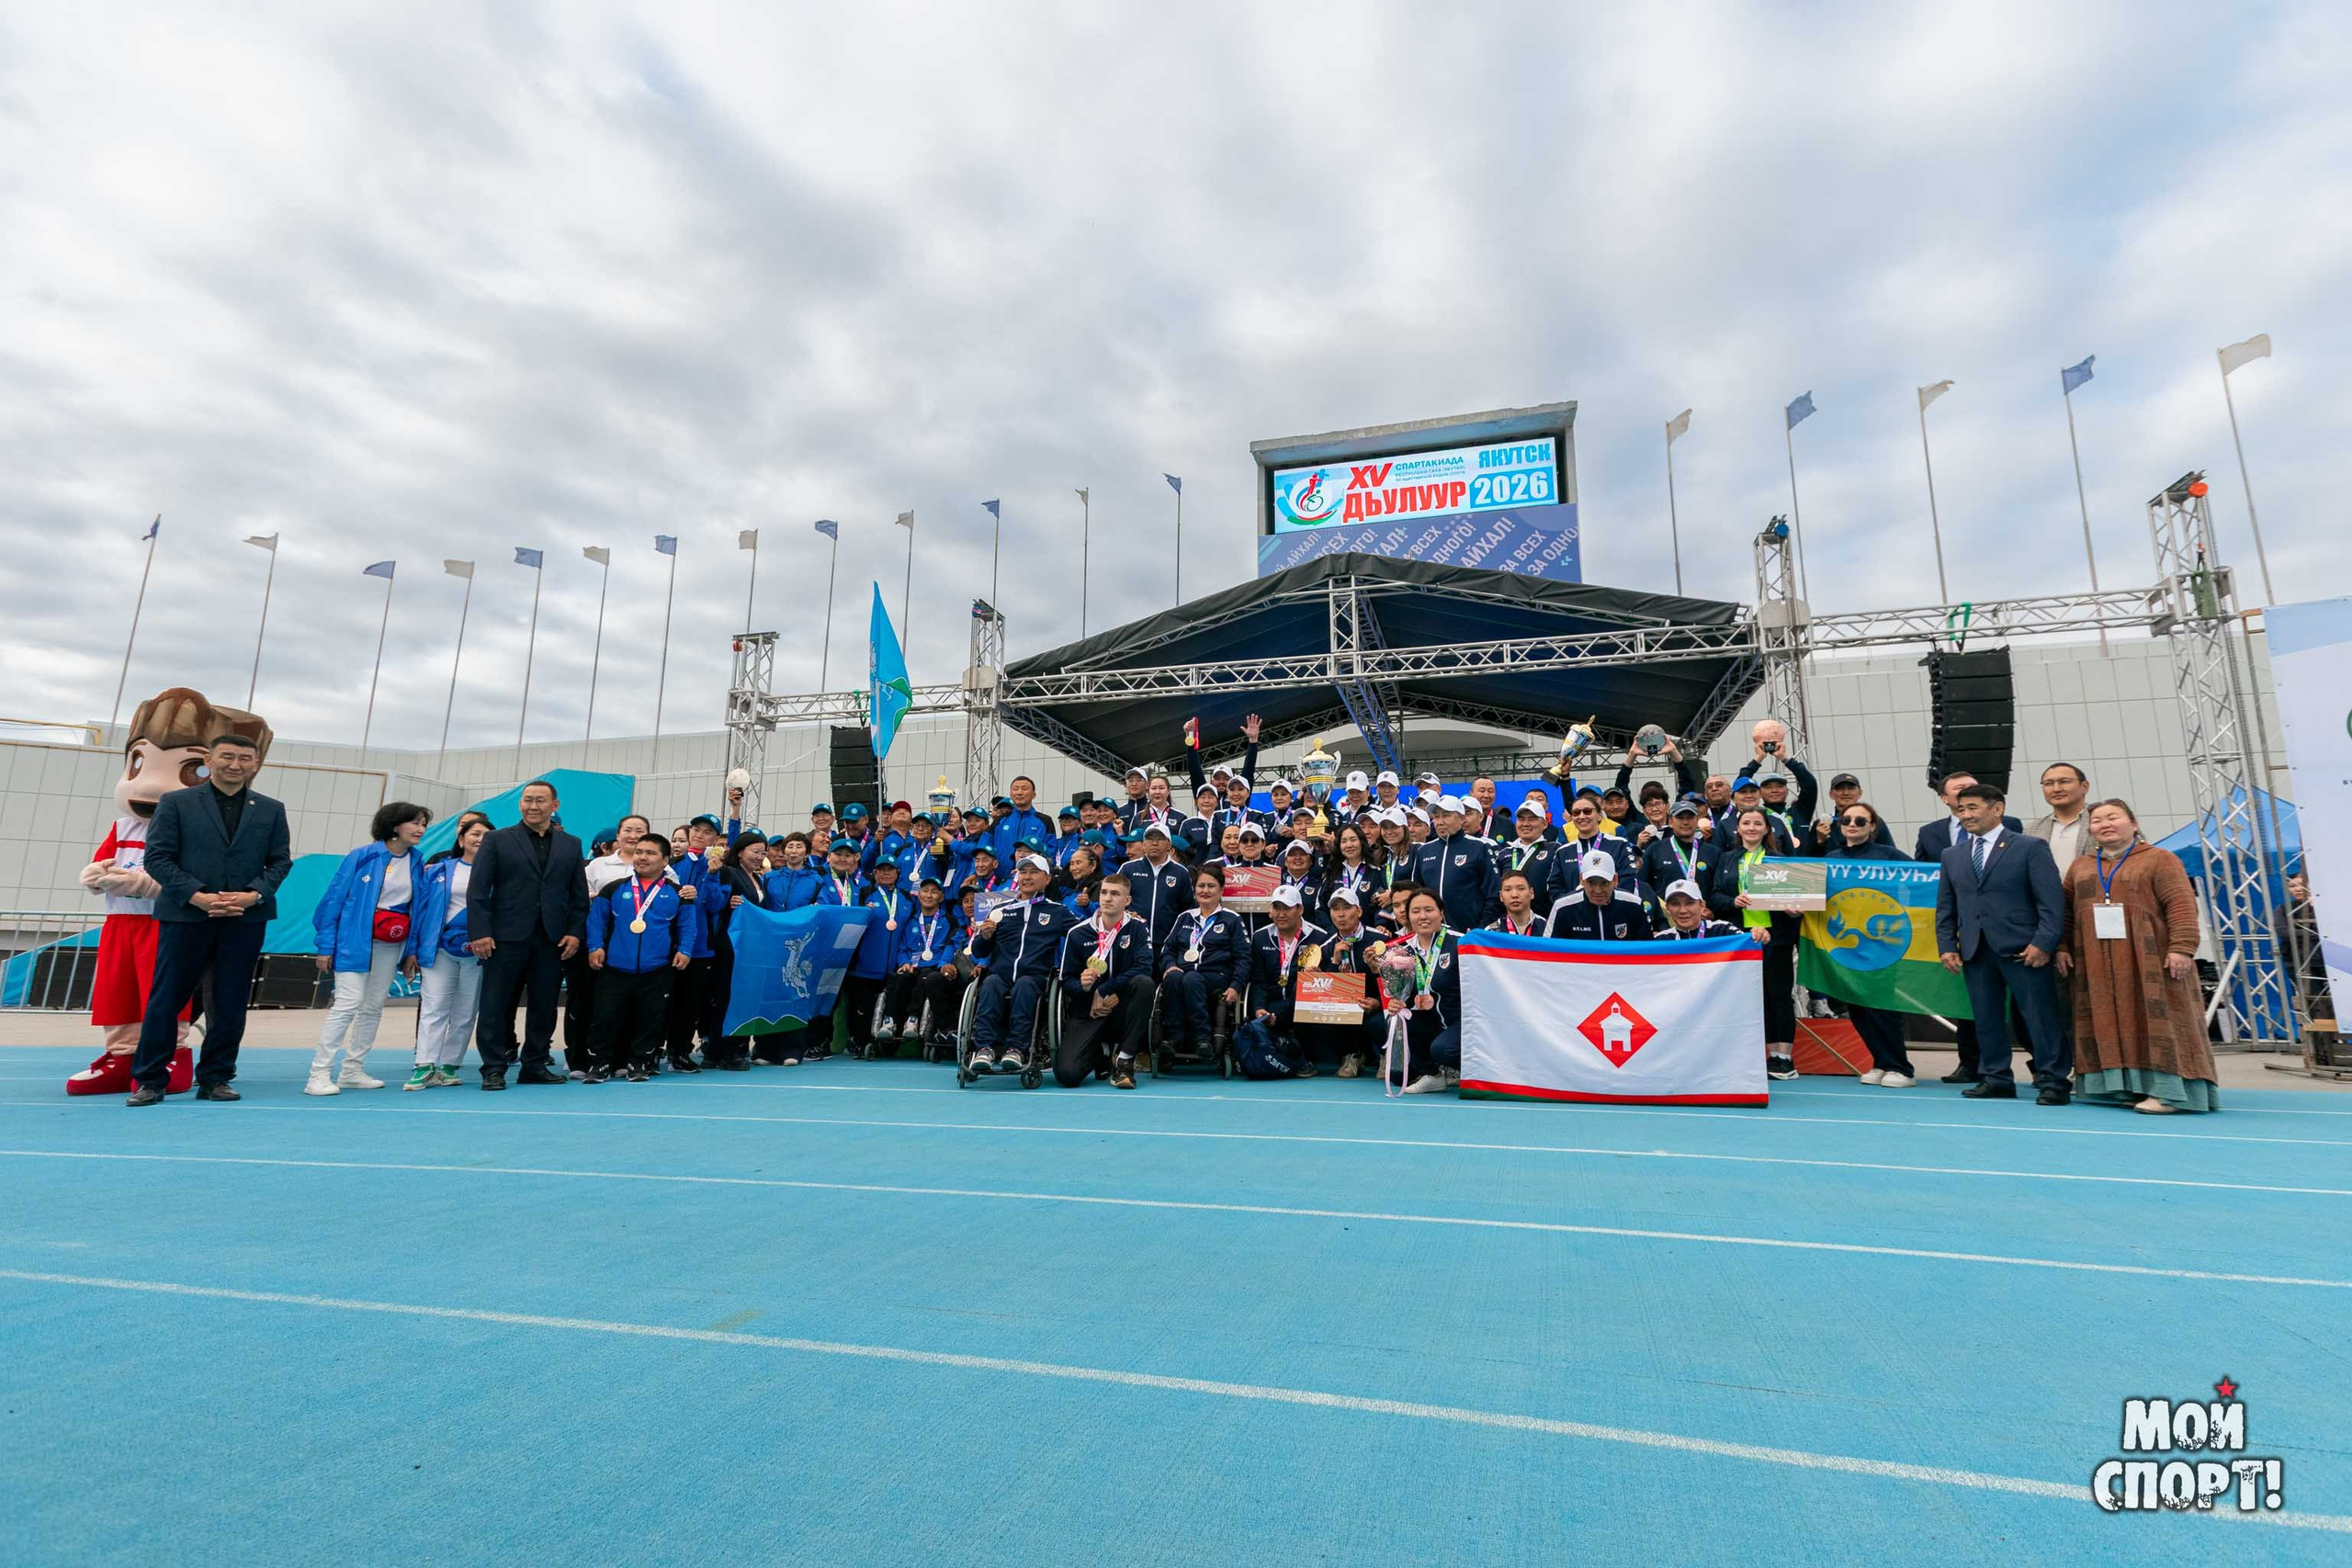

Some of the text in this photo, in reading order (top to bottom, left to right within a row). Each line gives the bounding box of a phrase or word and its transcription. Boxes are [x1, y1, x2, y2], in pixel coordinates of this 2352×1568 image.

[1396, 456, 1464, 470] СПАРТАКИАДА
[1478, 443, 1551, 468] ЯКУТСК
[1347, 463, 1394, 490] XV
[1474, 471, 1549, 504] 2026
[1342, 480, 1467, 524] ДЬУЛУУР
[1410, 525, 1442, 556] ВСЕХ
[1512, 529, 1547, 562] ВСЕХ
[1527, 525, 1579, 576] ЗА ОДНО
